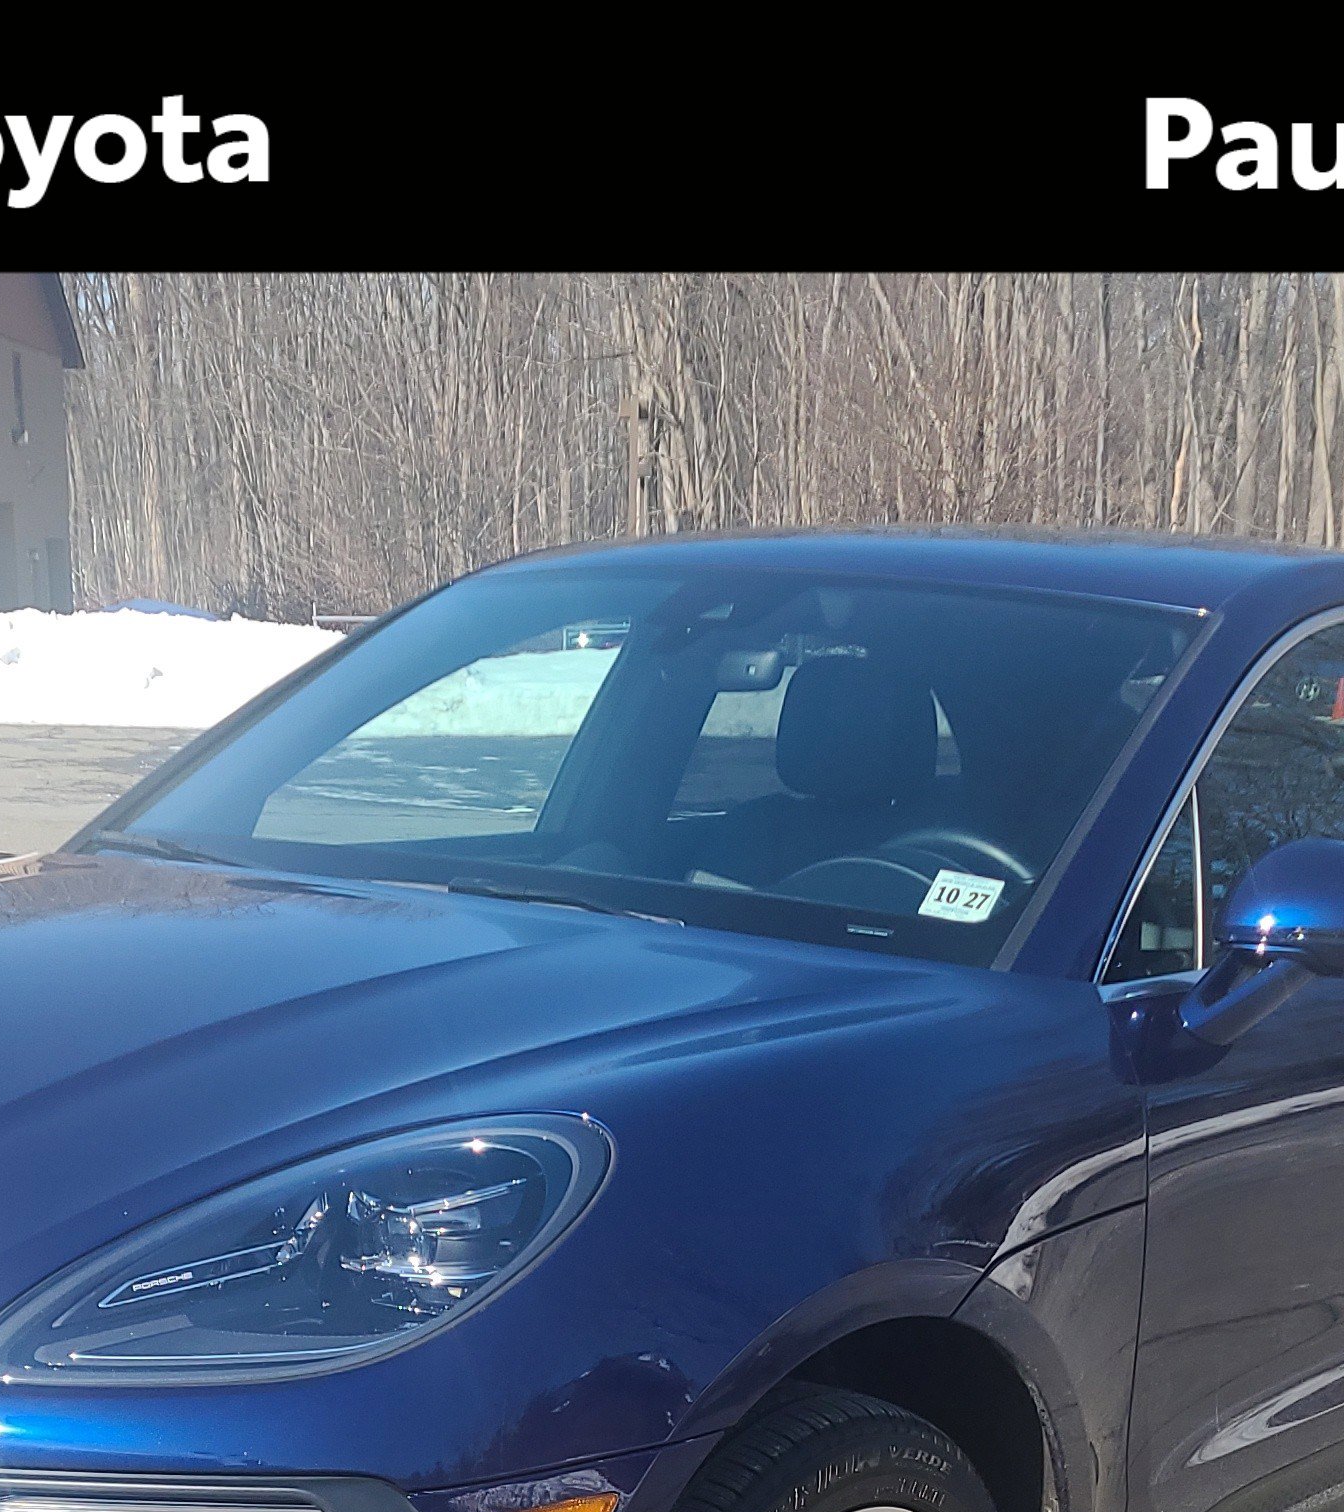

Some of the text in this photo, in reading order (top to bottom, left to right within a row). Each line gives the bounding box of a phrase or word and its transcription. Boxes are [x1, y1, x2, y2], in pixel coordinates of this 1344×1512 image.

[934, 886, 991, 909] 10 27
[133, 1271, 193, 1292] PORSCHE
